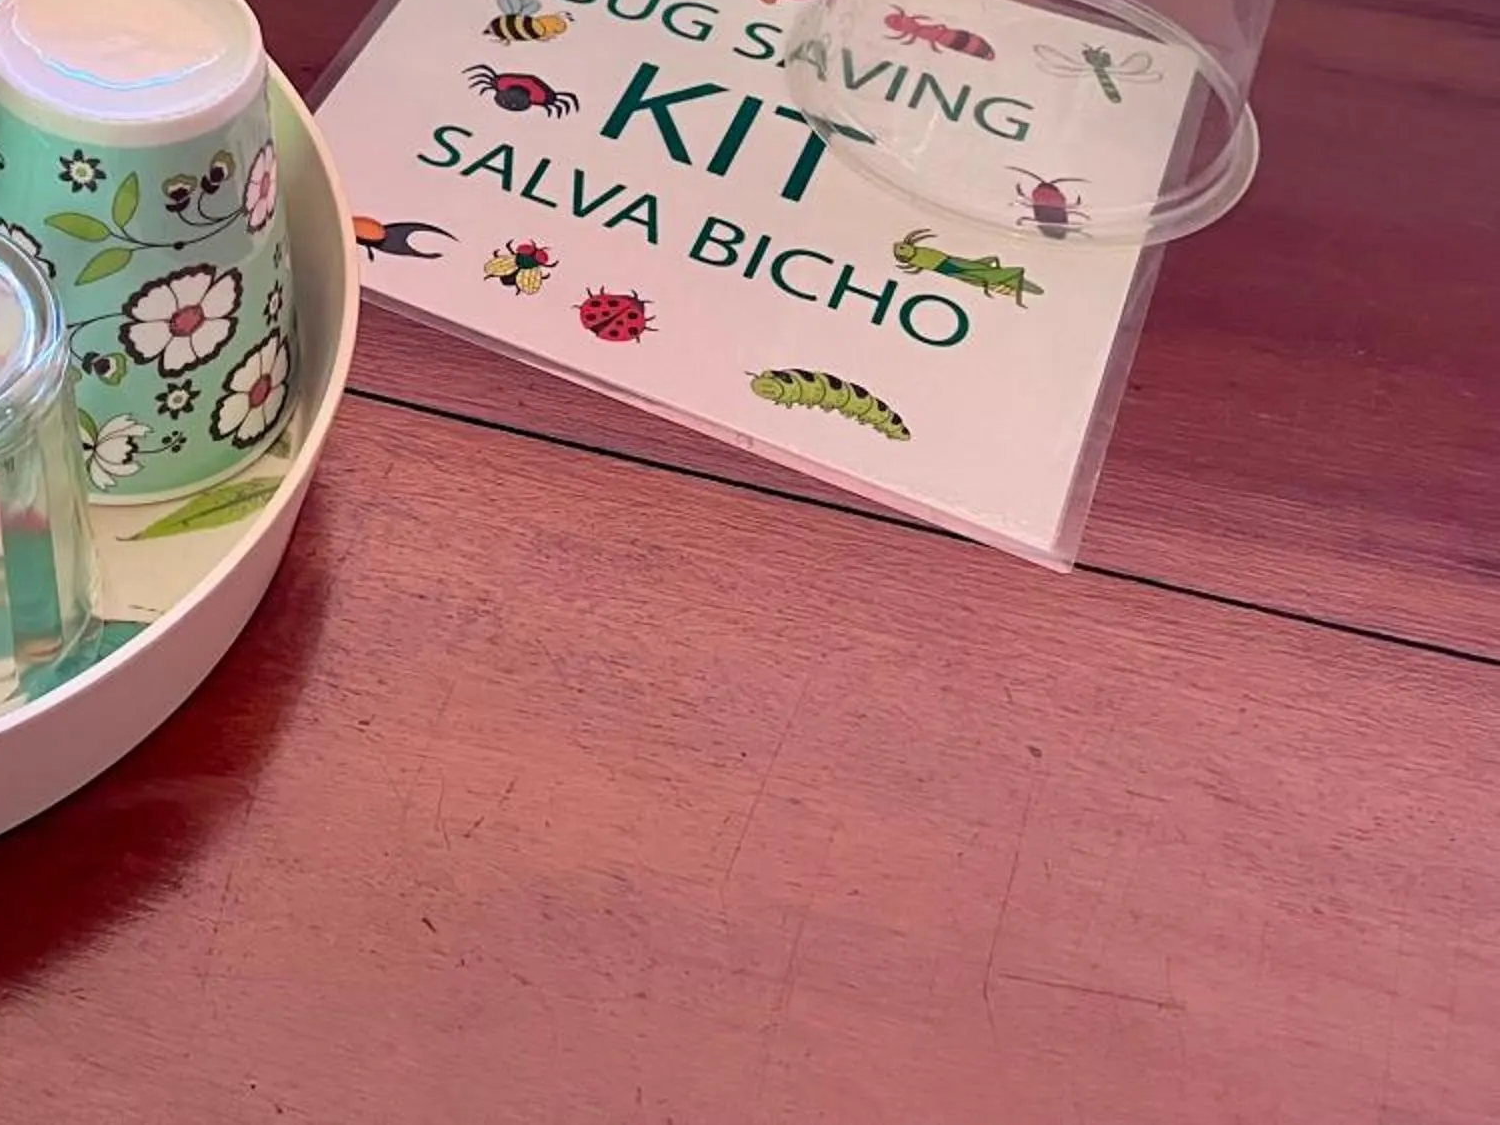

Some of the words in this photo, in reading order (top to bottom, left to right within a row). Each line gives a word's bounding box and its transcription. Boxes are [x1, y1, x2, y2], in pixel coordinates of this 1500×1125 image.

[600, 62, 877, 203] KIT
[732, 21, 1034, 142] SAVING
[417, 125, 660, 244] SALVA
[688, 216, 970, 348] BICHO
